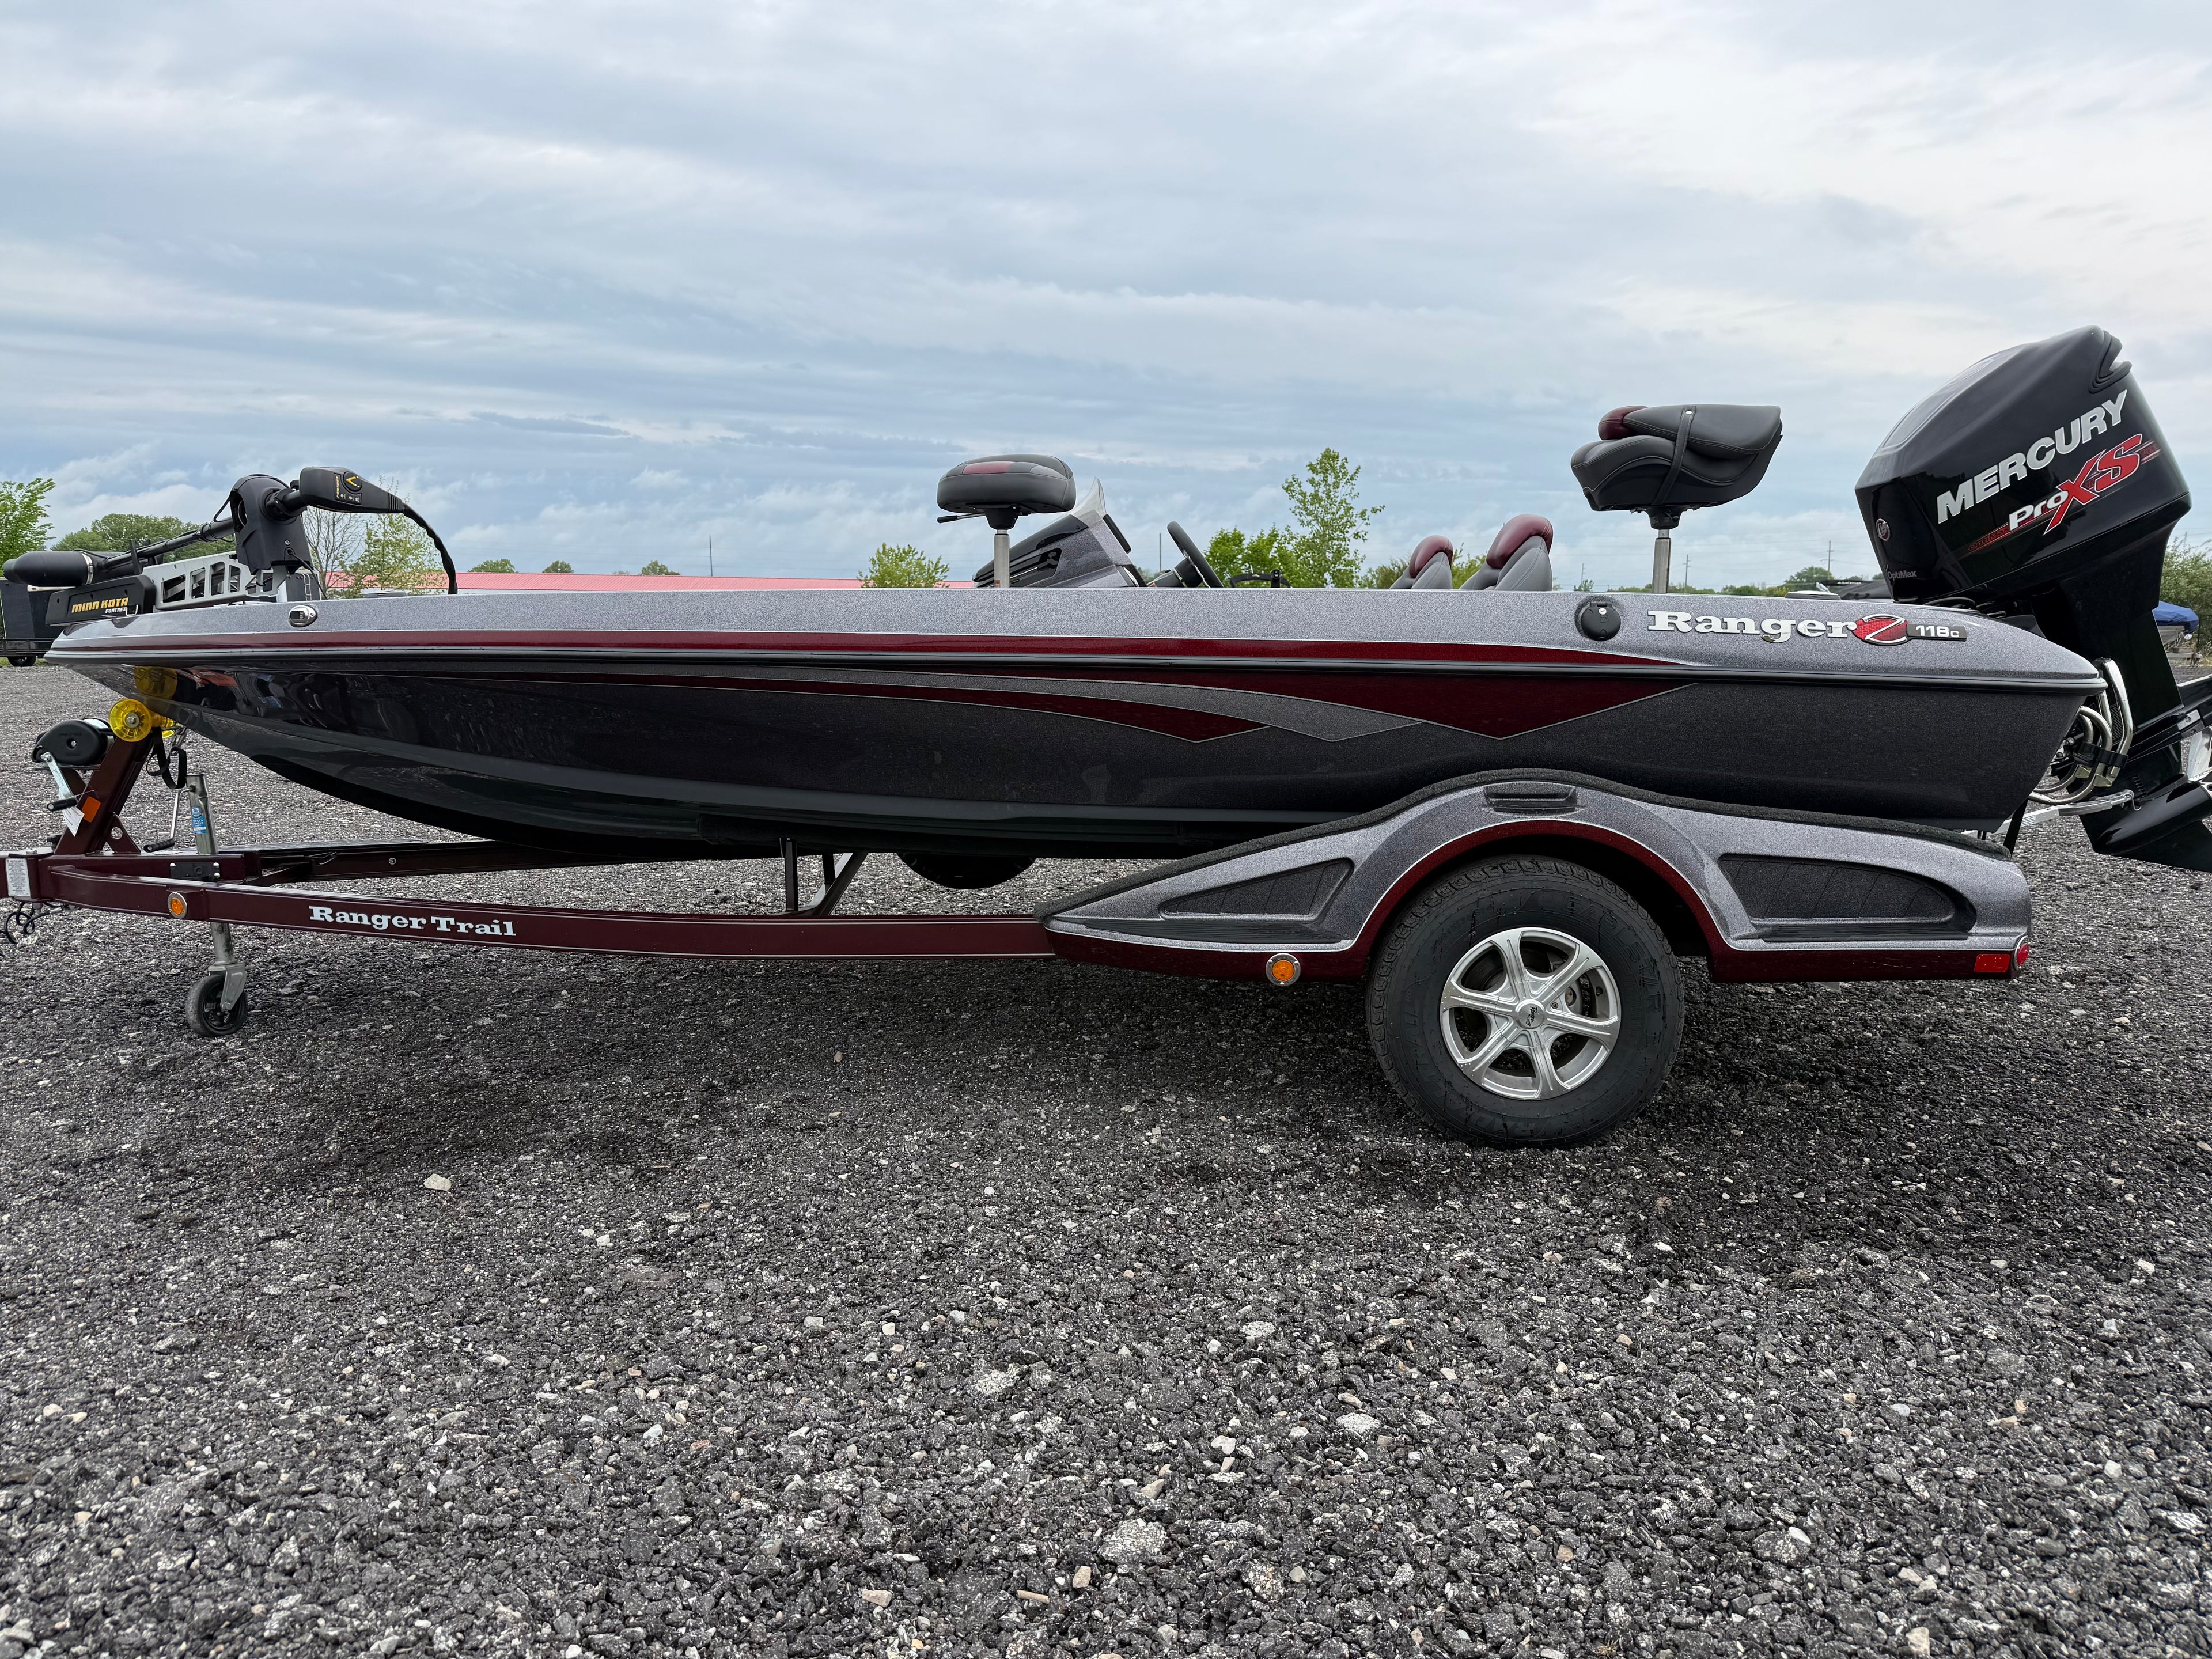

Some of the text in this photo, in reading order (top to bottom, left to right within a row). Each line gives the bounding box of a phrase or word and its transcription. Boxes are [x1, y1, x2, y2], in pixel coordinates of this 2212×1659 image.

[1937, 389, 2127, 524] MERCURY
[1887, 570, 1917, 581] OptiMax
[71, 597, 128, 613] MINN KOTA
[1647, 609, 1857, 643] Ranger
[309, 906, 516, 936] Ranger Trail
